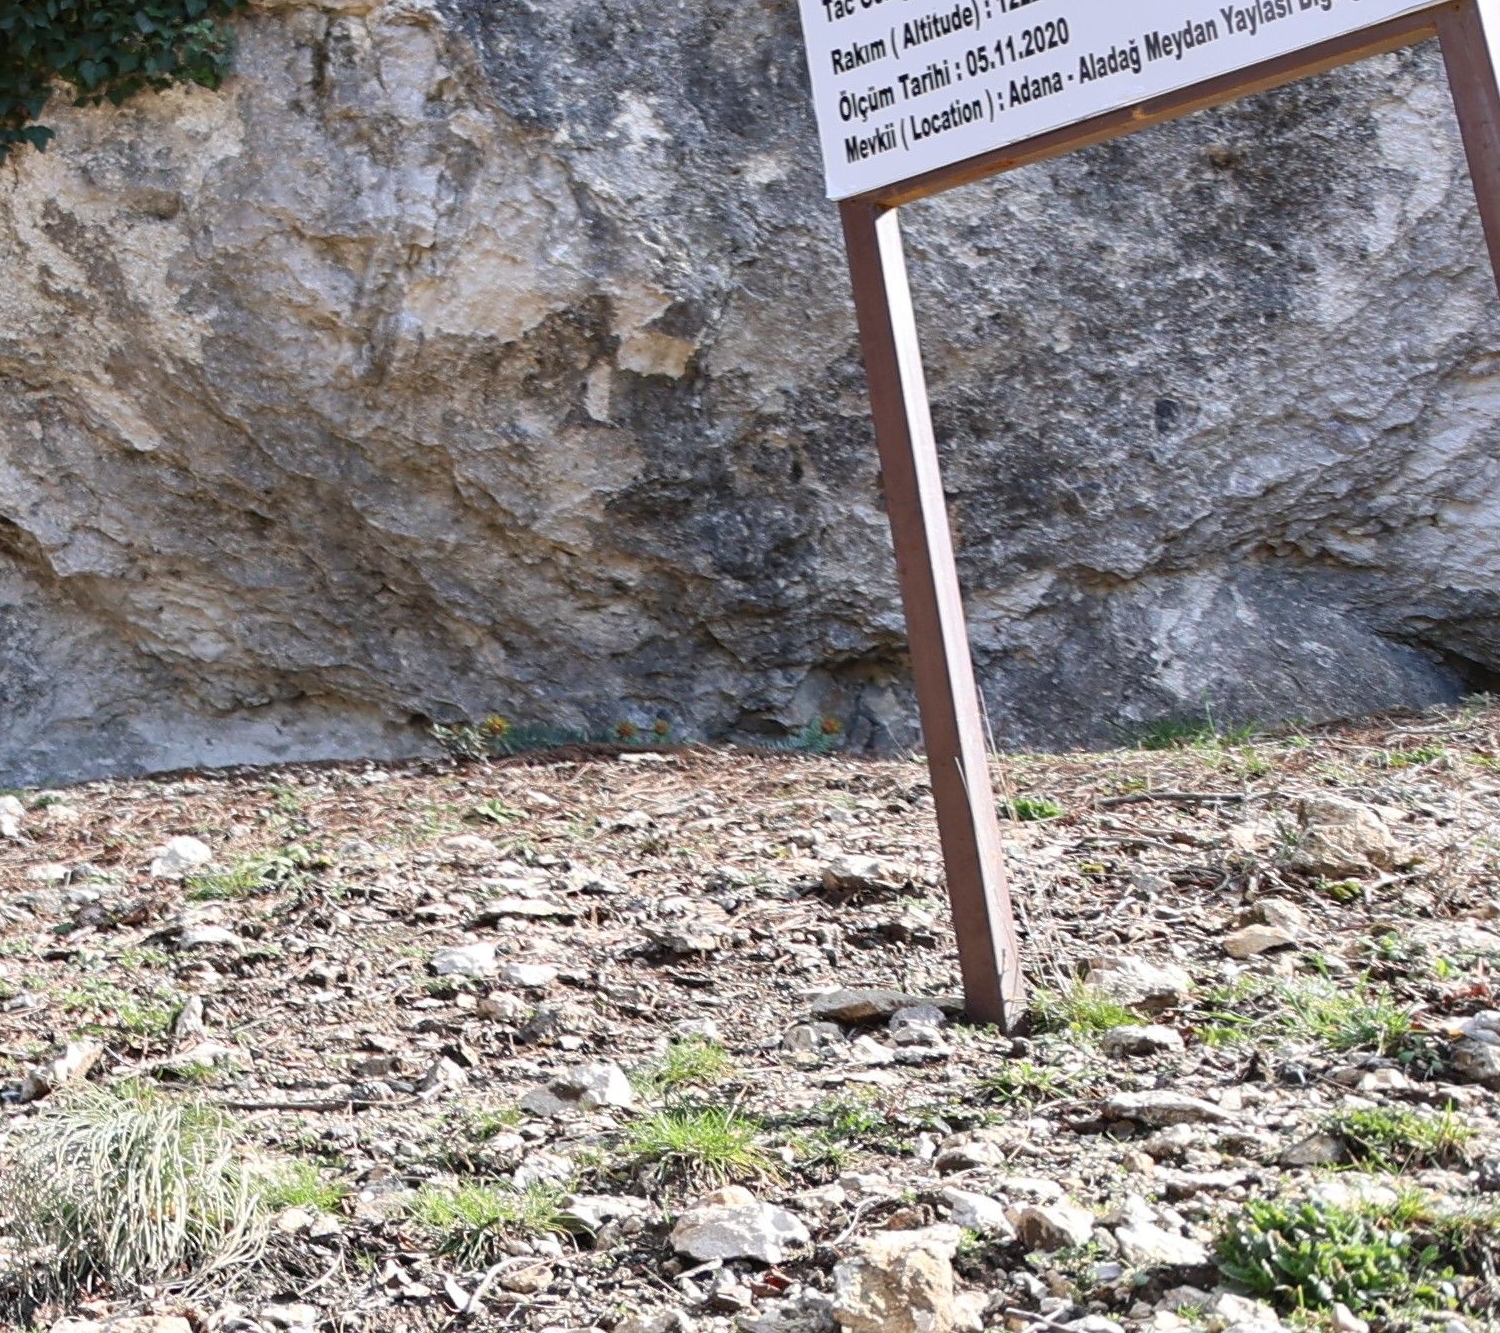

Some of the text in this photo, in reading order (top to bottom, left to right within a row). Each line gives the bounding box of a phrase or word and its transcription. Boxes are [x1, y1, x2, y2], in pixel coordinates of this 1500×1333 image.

[830, 38, 887, 76] Rakım
[838, 86, 896, 122] Ölçüm
[898, 59, 952, 100] Tarihi
[965, 17, 1070, 77] 05.11.2020
[844, 122, 897, 164] Mevkii
[910, 97, 983, 141] Location
[1009, 70, 1064, 108] Adana
[1079, 38, 1142, 84] Aladağ
[1144, 18, 1219, 62] Meydan
